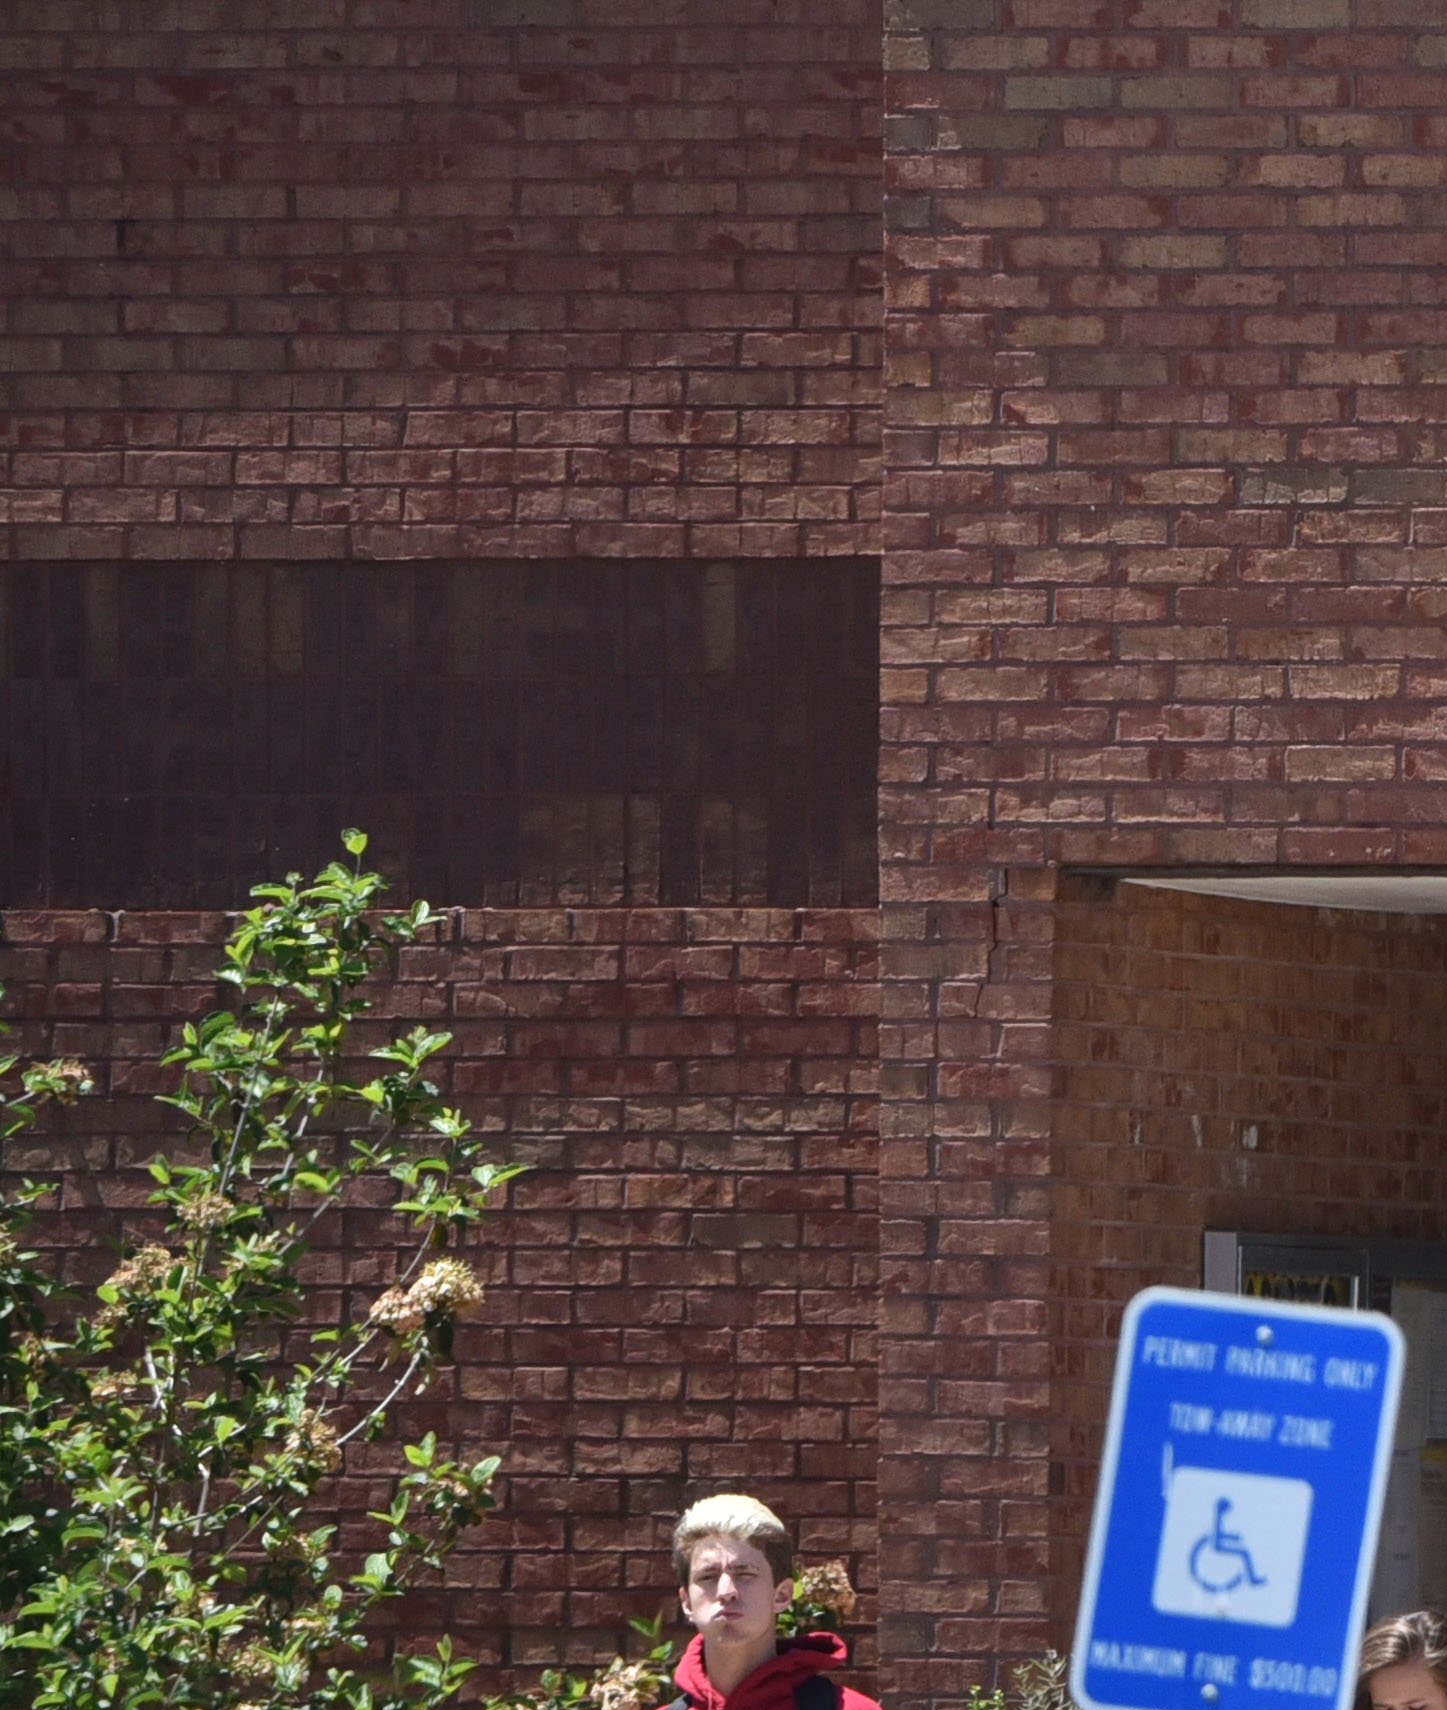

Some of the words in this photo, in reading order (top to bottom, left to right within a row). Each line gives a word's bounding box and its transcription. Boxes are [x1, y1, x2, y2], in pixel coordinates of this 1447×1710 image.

[1142, 1334, 1217, 1372] PERMIT
[1225, 1345, 1316, 1383] PARKING
[1323, 1356, 1377, 1390] ONLY
[1278, 1414, 1333, 1450] ZONE
[1088, 1639, 1187, 1678] MAXIMUM
[1193, 1651, 1239, 1687] FINE
[1250, 1656, 1338, 1698] $500.00
